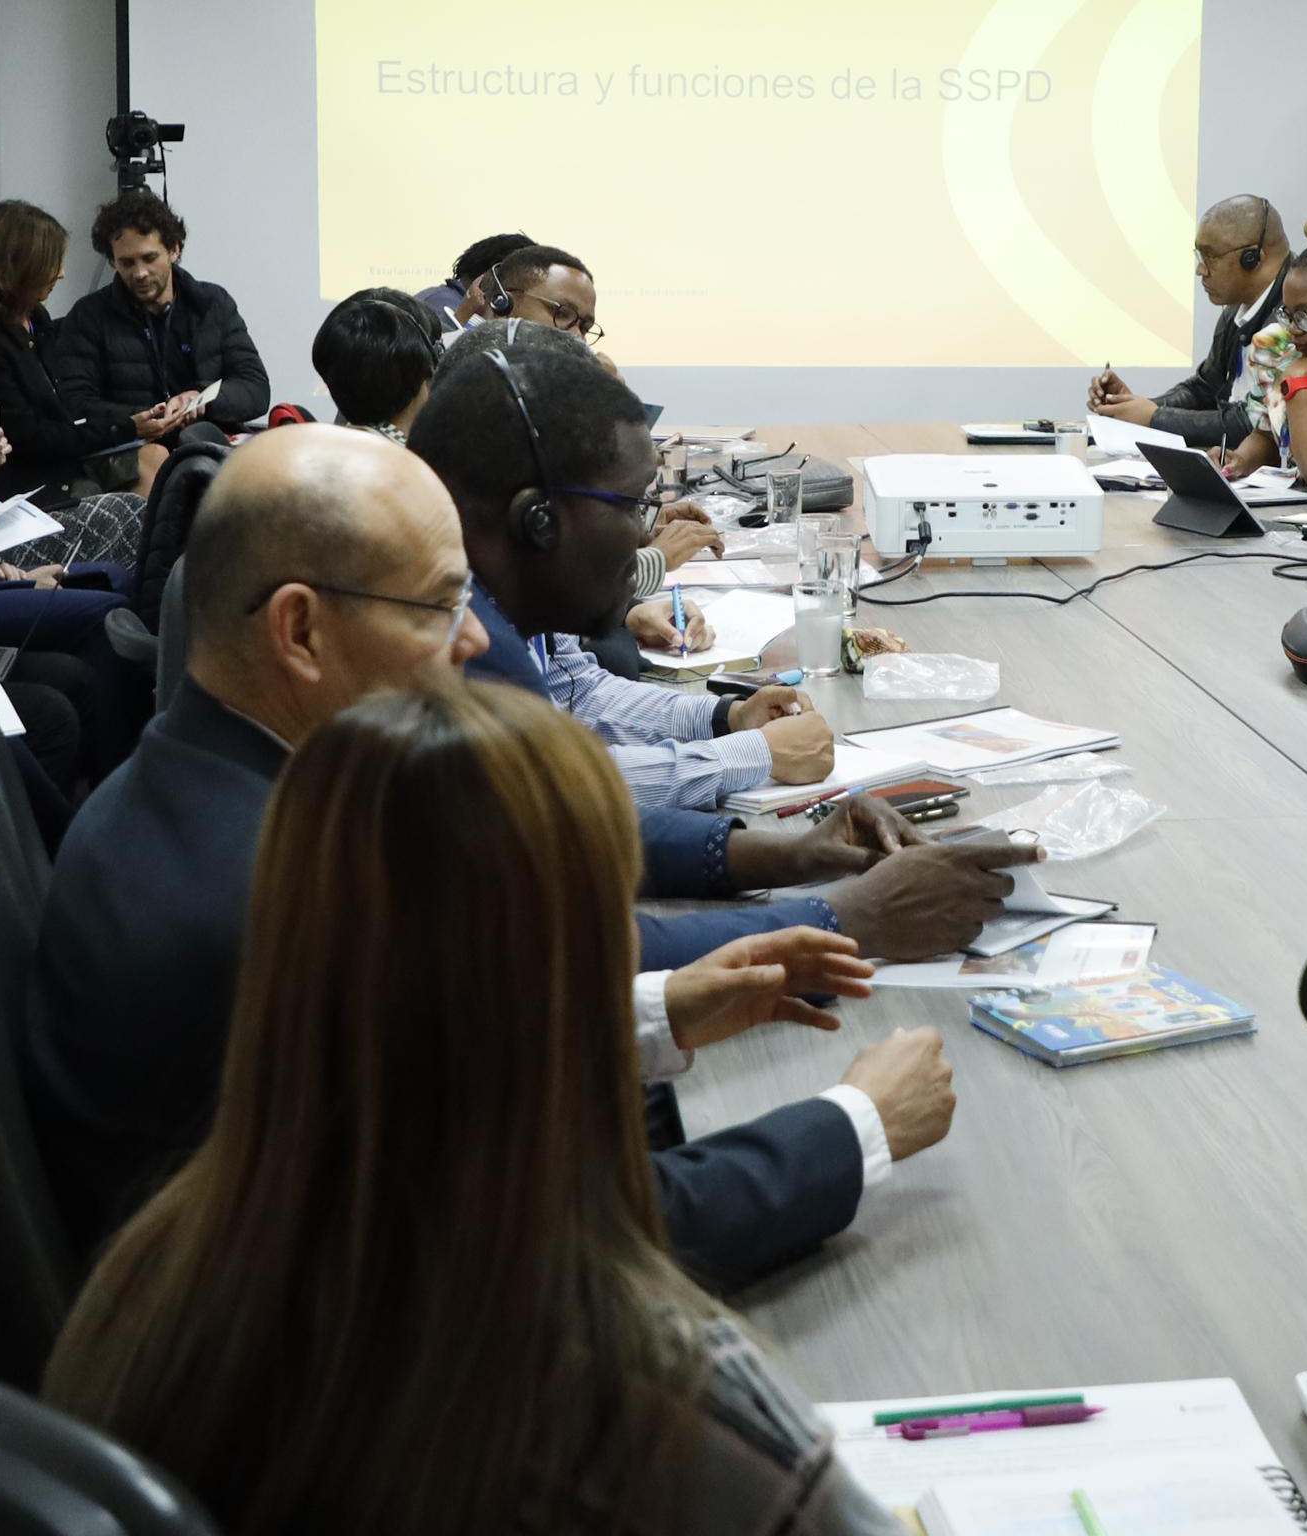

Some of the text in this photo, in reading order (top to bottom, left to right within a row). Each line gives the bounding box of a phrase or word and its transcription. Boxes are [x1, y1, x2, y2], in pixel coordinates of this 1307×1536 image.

[377, 59, 1053, 105] Estructura y funciones de la SSPD
